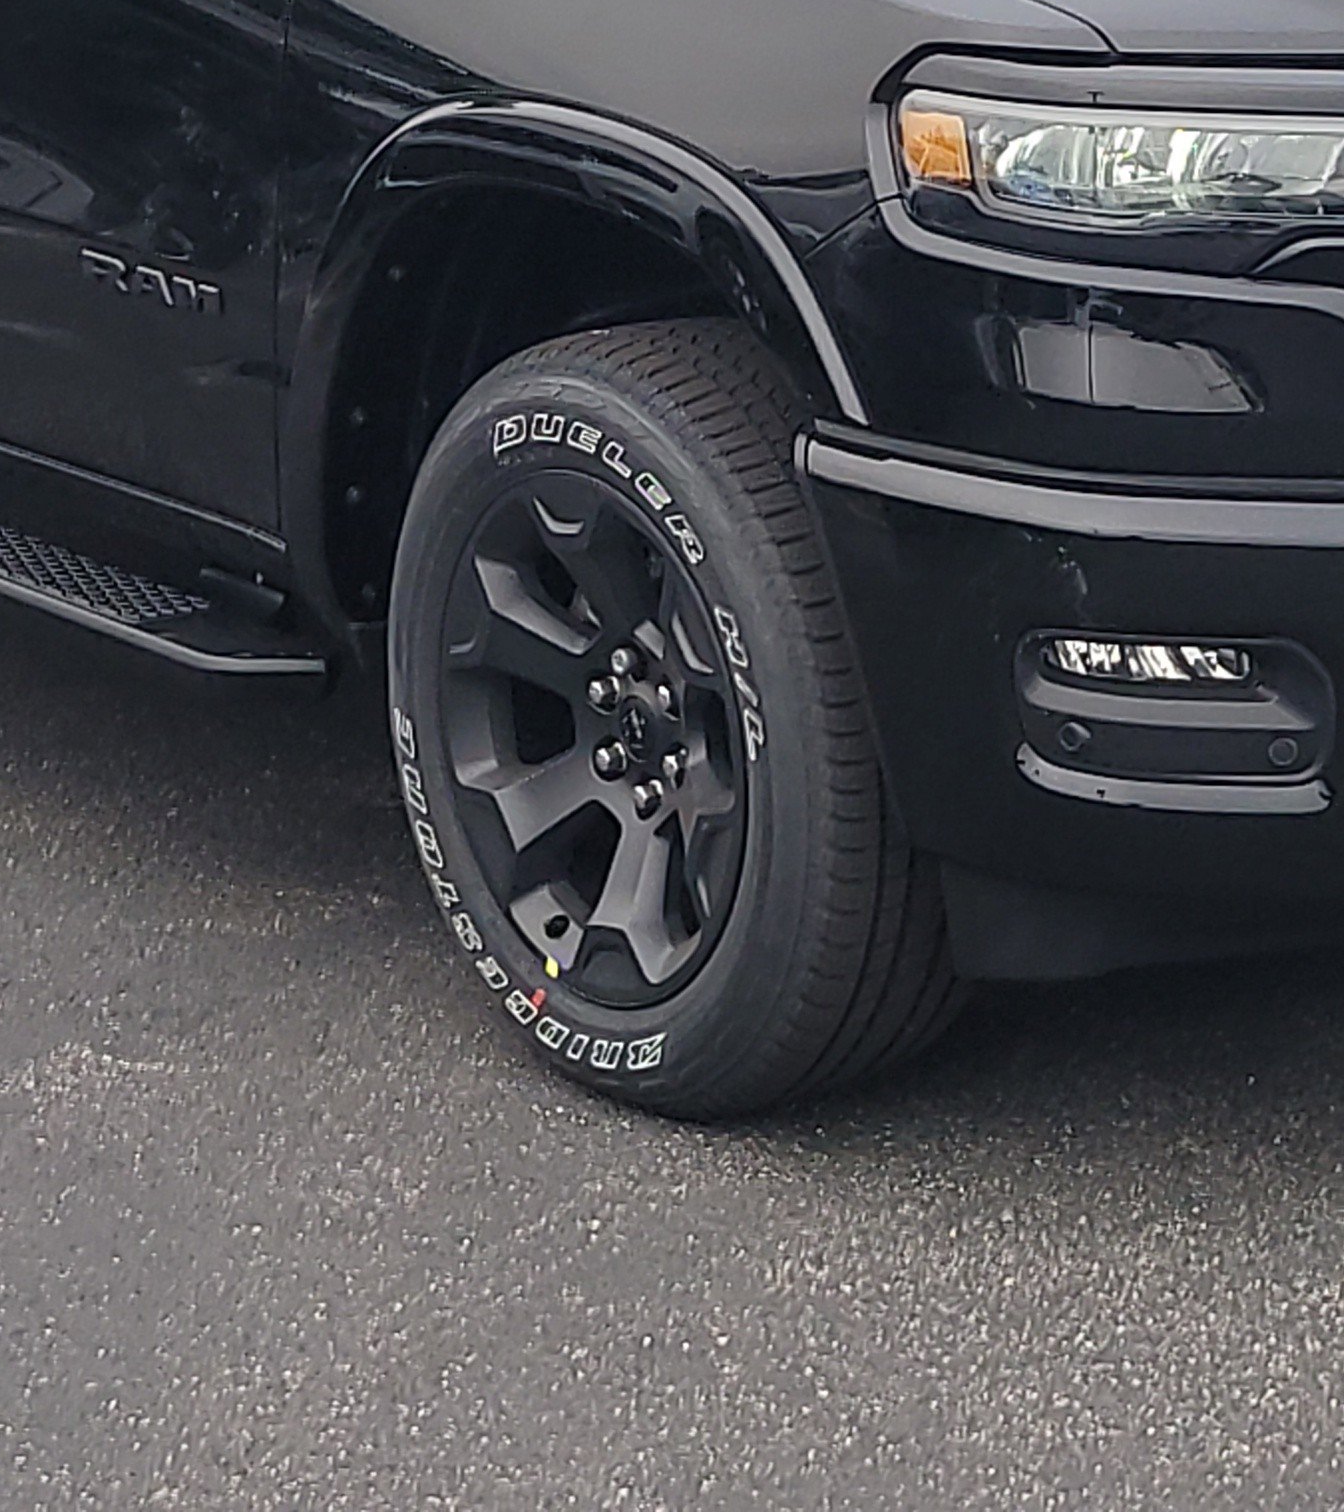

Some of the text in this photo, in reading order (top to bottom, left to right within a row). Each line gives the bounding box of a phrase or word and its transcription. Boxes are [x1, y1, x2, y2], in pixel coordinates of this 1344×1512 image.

[80, 247, 224, 314] RAM
[493, 412, 704, 565] DUELER
[714, 604, 767, 761] H/L
[394, 707, 668, 1070] BRIDGESTONE
